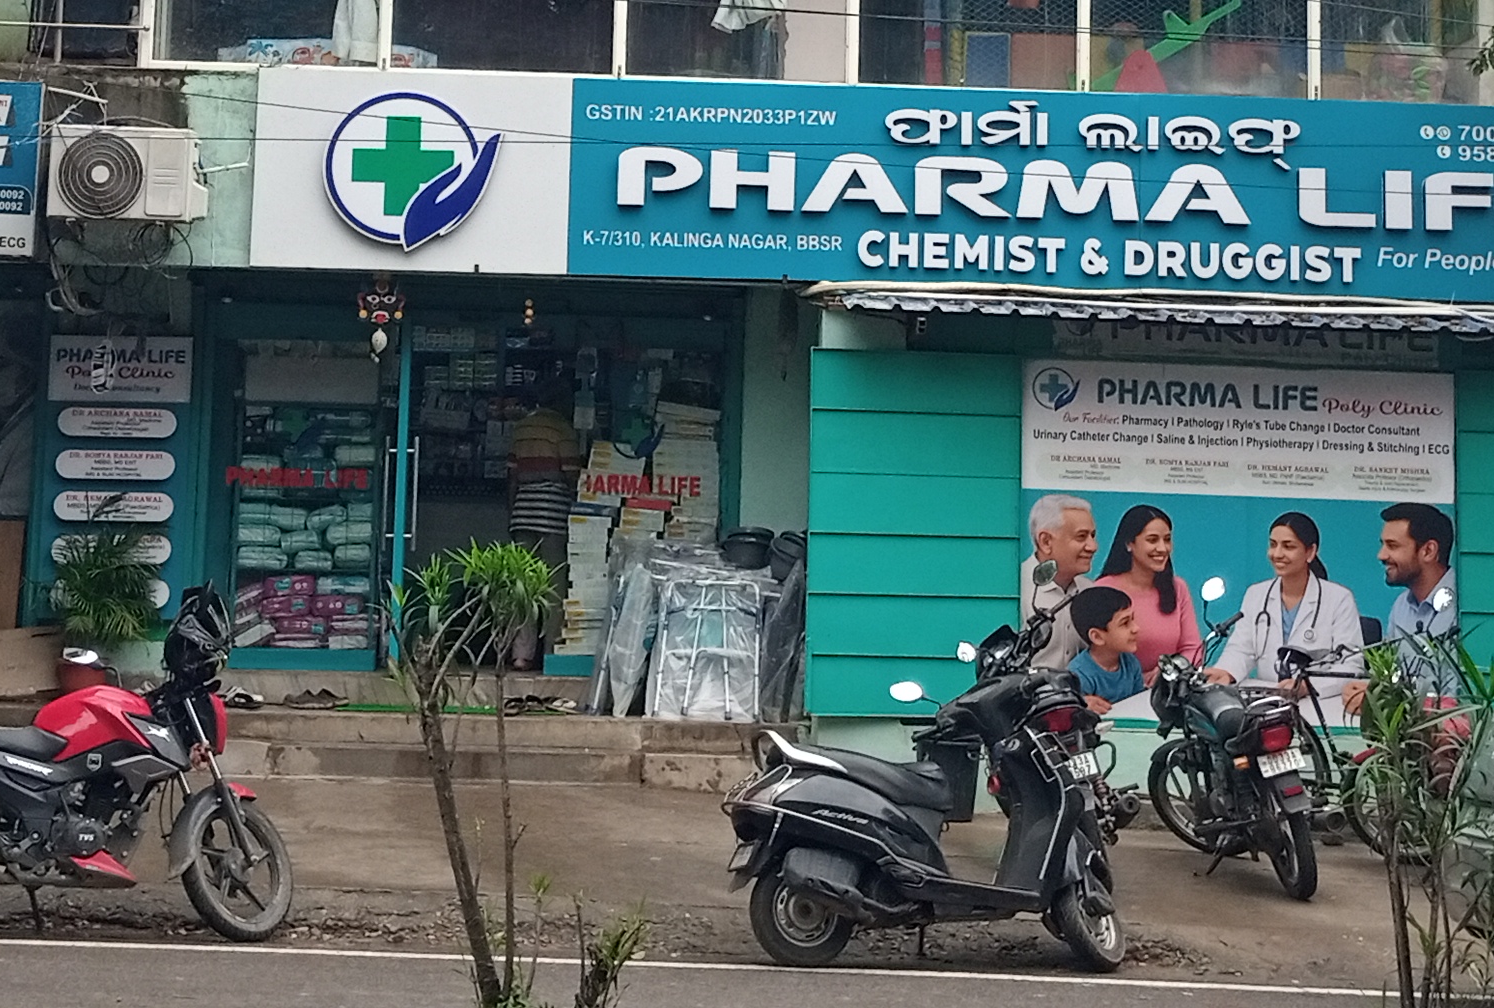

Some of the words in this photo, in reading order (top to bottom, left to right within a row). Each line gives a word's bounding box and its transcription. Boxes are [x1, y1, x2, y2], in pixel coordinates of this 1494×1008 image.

[585, 104, 643, 122] GSTIN
[616, 146, 1251, 225] PHARMA
[0, 237, 26, 249] ECG
[583, 230, 645, 249] K-7/310,
[650, 231, 724, 249] KALINGA
[728, 233, 792, 252] NAGAR,
[796, 234, 842, 252] BBSR
[857, 229, 1066, 273] CHEMIST
[1080, 240, 1109, 276] &
[1124, 239, 1362, 284] DRUGGIST
[1376, 247, 1417, 268] For
[56, 348, 141, 363] PHAMA
[148, 349, 187, 364] LIFE
[118, 366, 175, 379] Clinic
[1097, 378, 1242, 409] PHARMA
[1252, 384, 1318, 412] LIFE
[1322, 398, 1375, 419] Poly
[1379, 399, 1443, 416] Clinic
[1122, 415, 1169, 429] Pharmacy
[1177, 417, 1224, 431] Pathology
[1232, 420, 1261, 432] Ryle's
[1263, 420, 1287, 432] Tube
[1289, 421, 1325, 435] Change
[1333, 423, 1365, 435] Doctor
[1367, 425, 1420, 436] Consultant
[1033, 429, 1067, 443] Urinary
[1070, 430, 1110, 442] Catheter
[1112, 432, 1148, 446] Change
[1157, 434, 1185, 445] Saline
[1188, 435, 1195, 445] &
[1198, 435, 1238, 448] Injection
[1246, 437, 1314, 452] Physiotherapy
[1322, 440, 1364, 454] Dressing
[1367, 442, 1375, 453] &
[1377, 442, 1420, 456] Stitching
[1429, 444, 1450, 455] ECG
[225, 466, 314, 487] PHARMA
[324, 468, 368, 489] LIFE
[658, 475, 701, 497] LIFE
[811, 809, 869, 824] Activa
[78, 833, 95, 841] TVS
